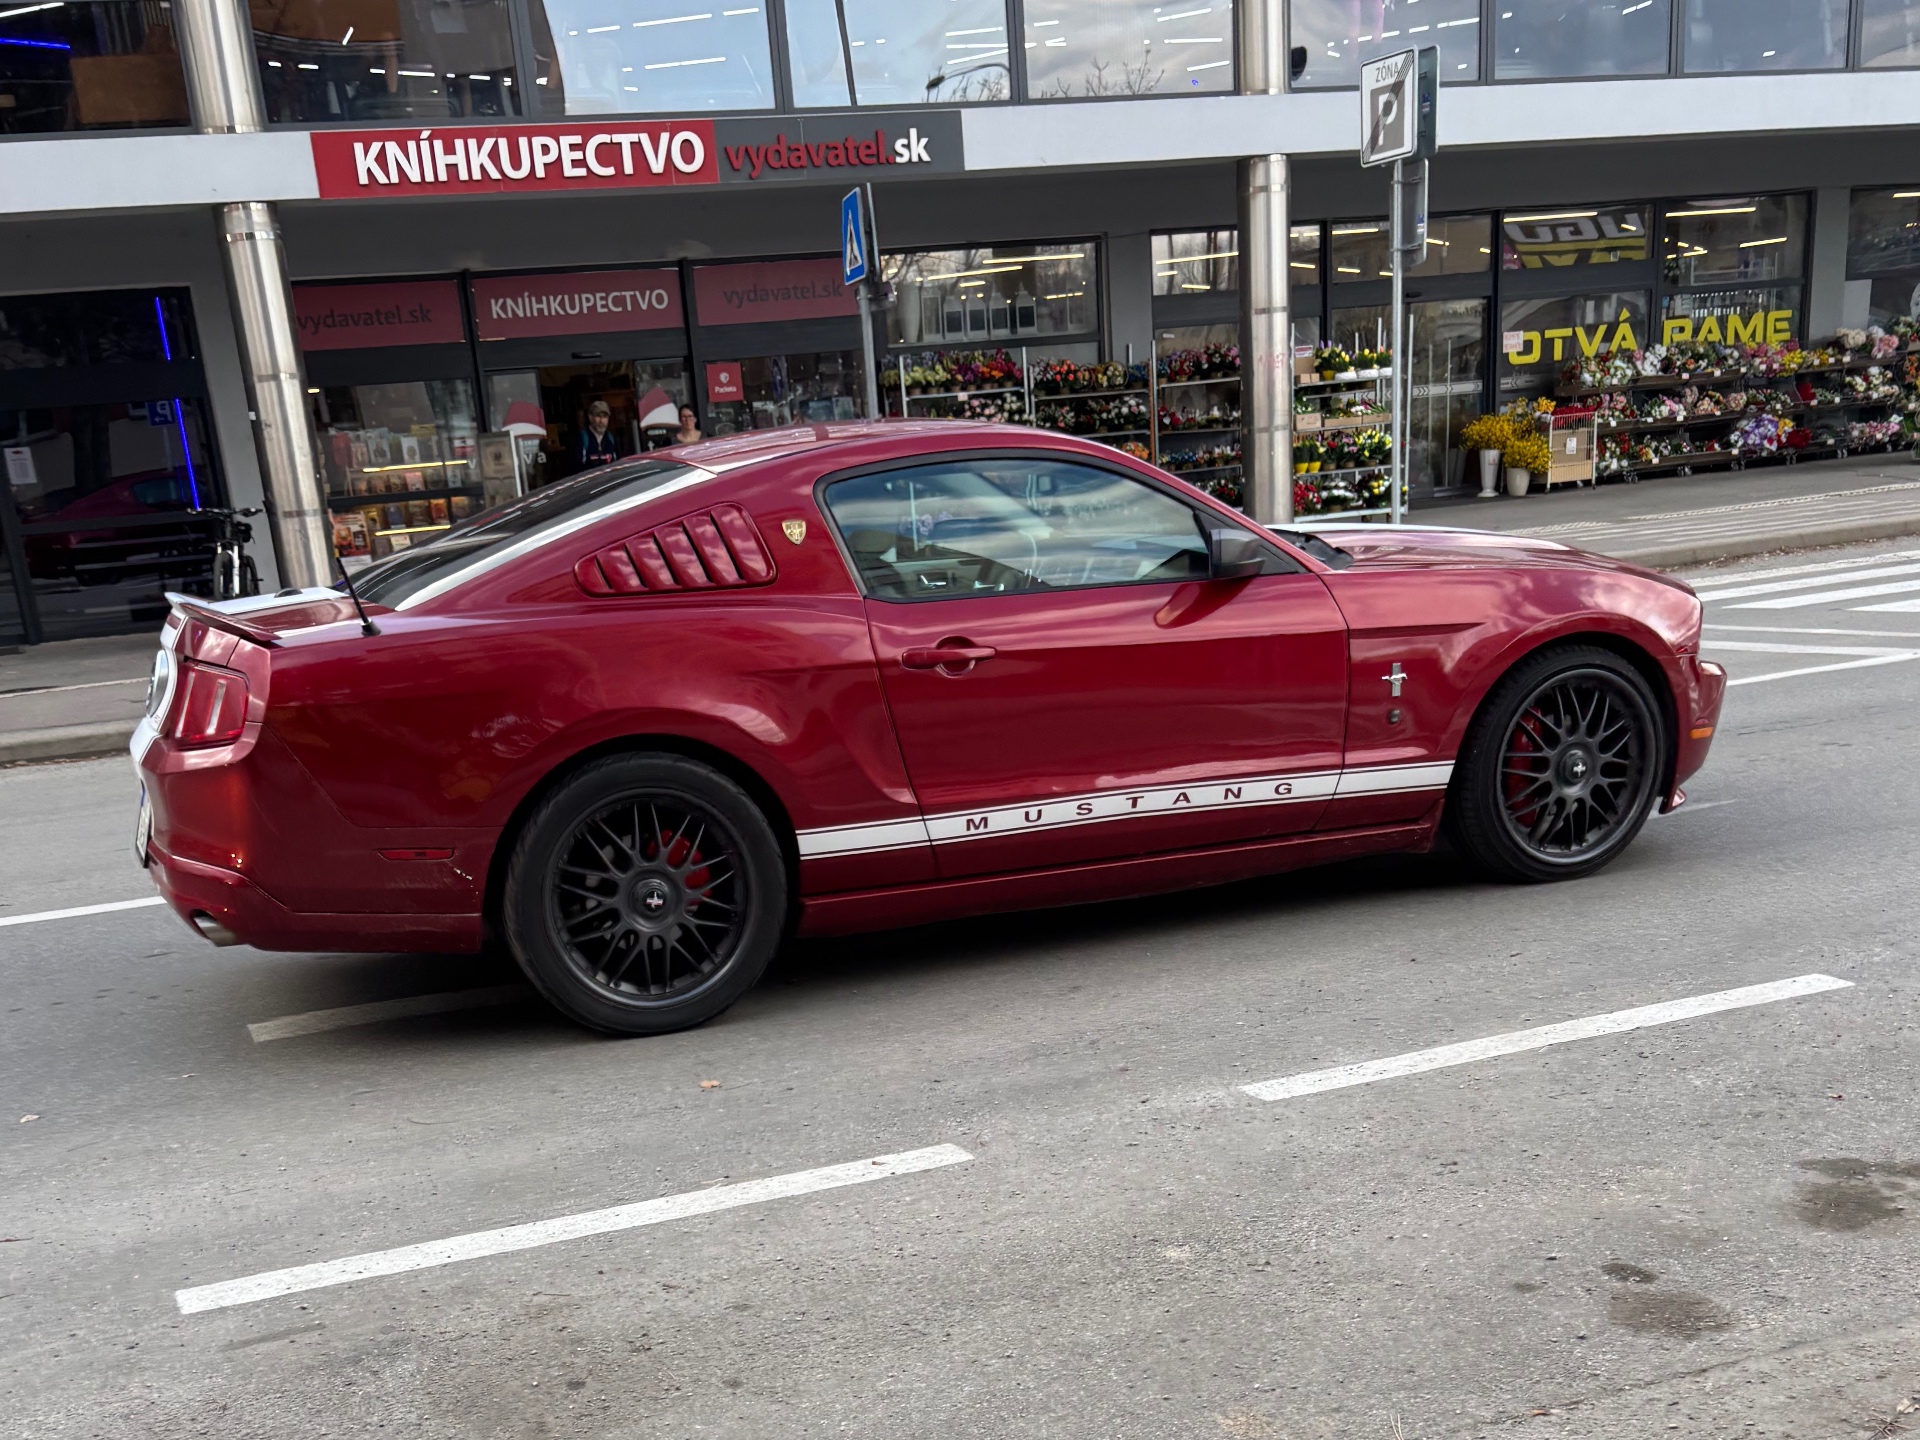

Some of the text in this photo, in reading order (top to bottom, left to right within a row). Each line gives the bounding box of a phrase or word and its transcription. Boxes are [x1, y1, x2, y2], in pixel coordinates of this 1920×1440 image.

[1375, 60, 1400, 83] ZÓNA
[353, 127, 932, 186] KNÍHKUPECTVO vydavatel.sk
[490, 288, 669, 320] KNÍHKUPECTVO
[723, 277, 843, 310] vydavatel.sk
[296, 303, 433, 335] vydavatel.sk
[966, 782, 1293, 832] MUSTANG
